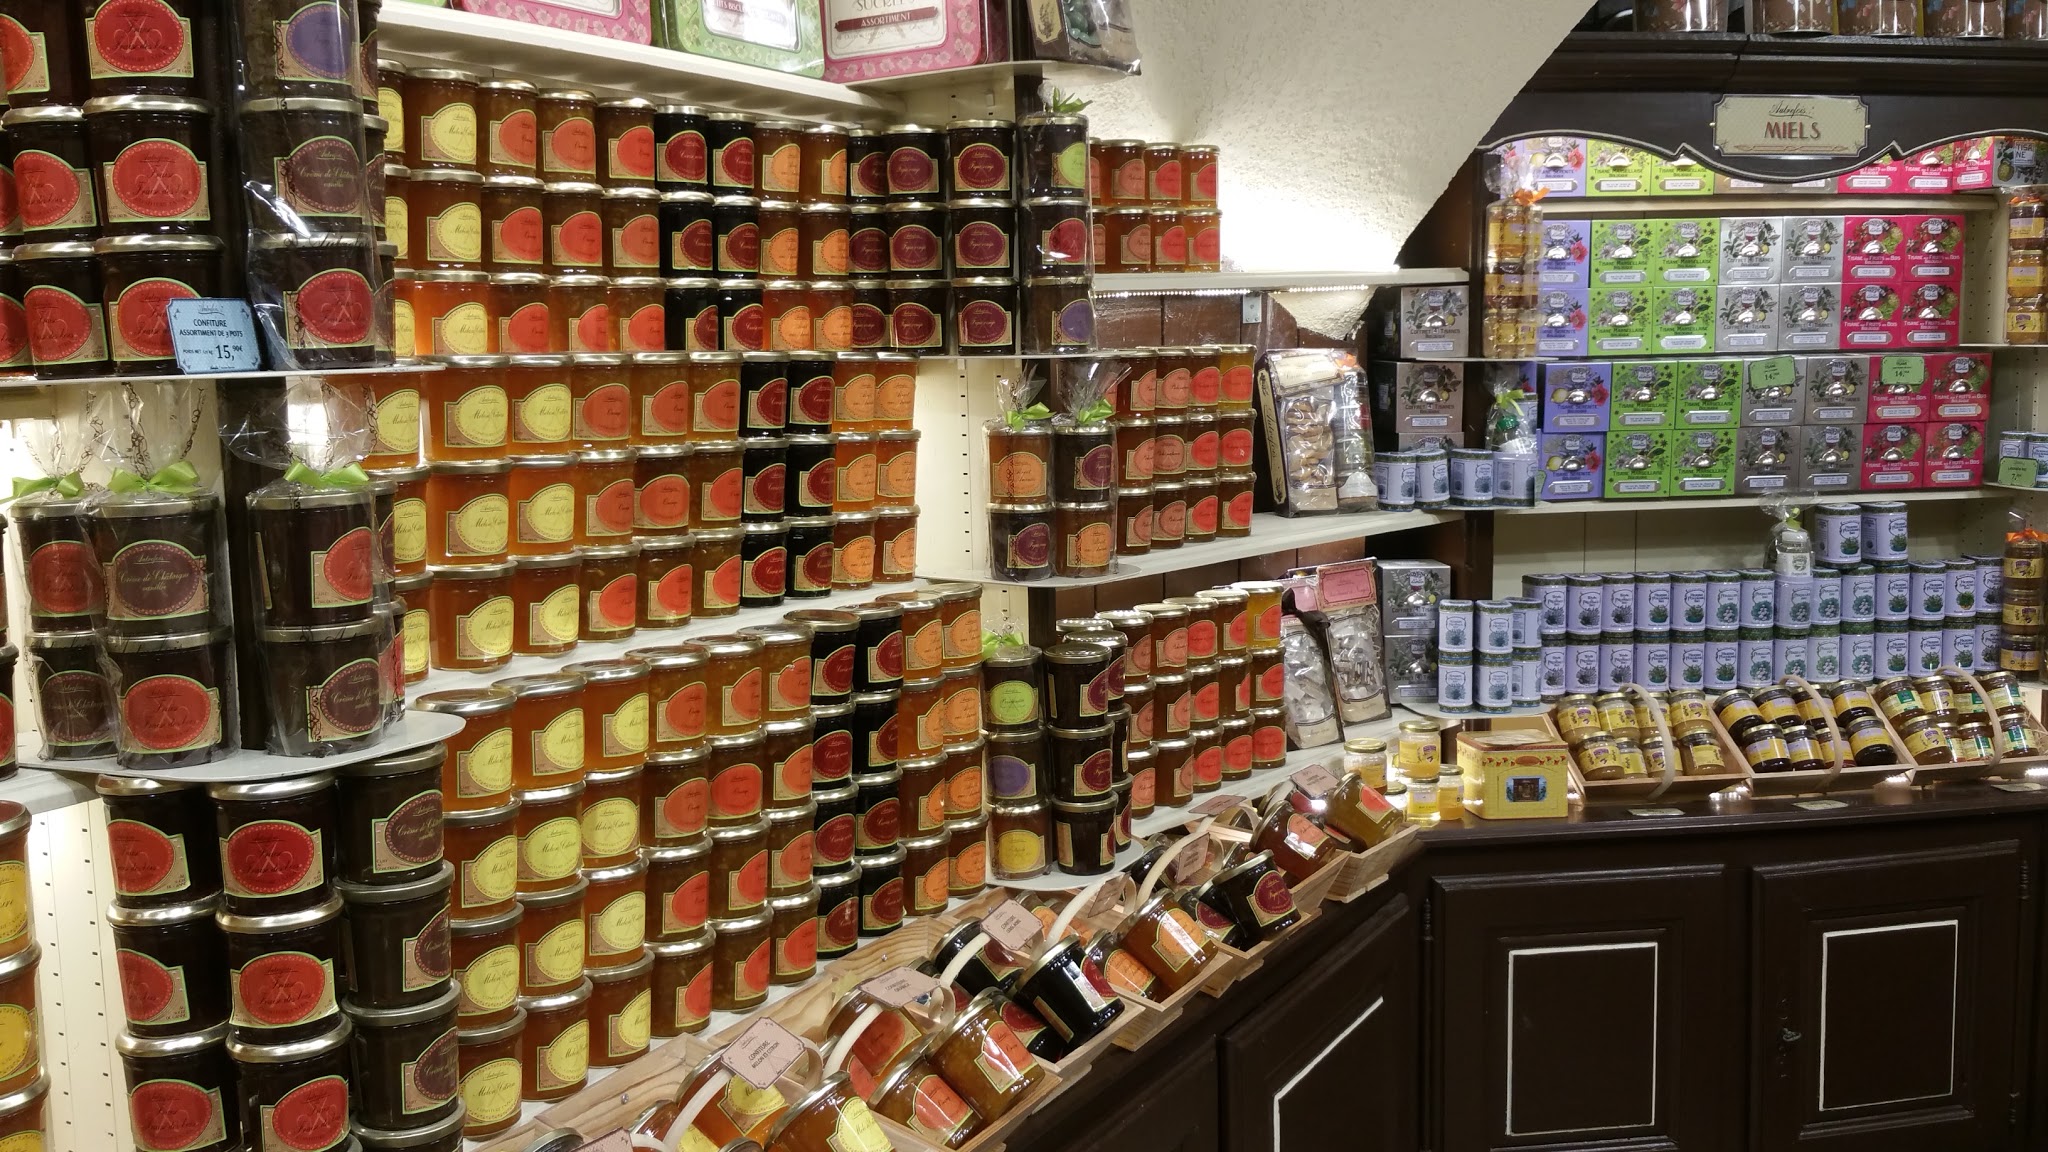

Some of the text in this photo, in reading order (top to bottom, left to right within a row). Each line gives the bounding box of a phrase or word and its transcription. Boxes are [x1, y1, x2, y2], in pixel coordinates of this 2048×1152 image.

[860, 12, 911, 27] ASSORTIMENT
[1768, 100, 1807, 118] Autrefois
[1764, 121, 1822, 140] MIELS
[193, 319, 227, 327] CONFITURE
[748, 1040, 770, 1061] CONFITURE
